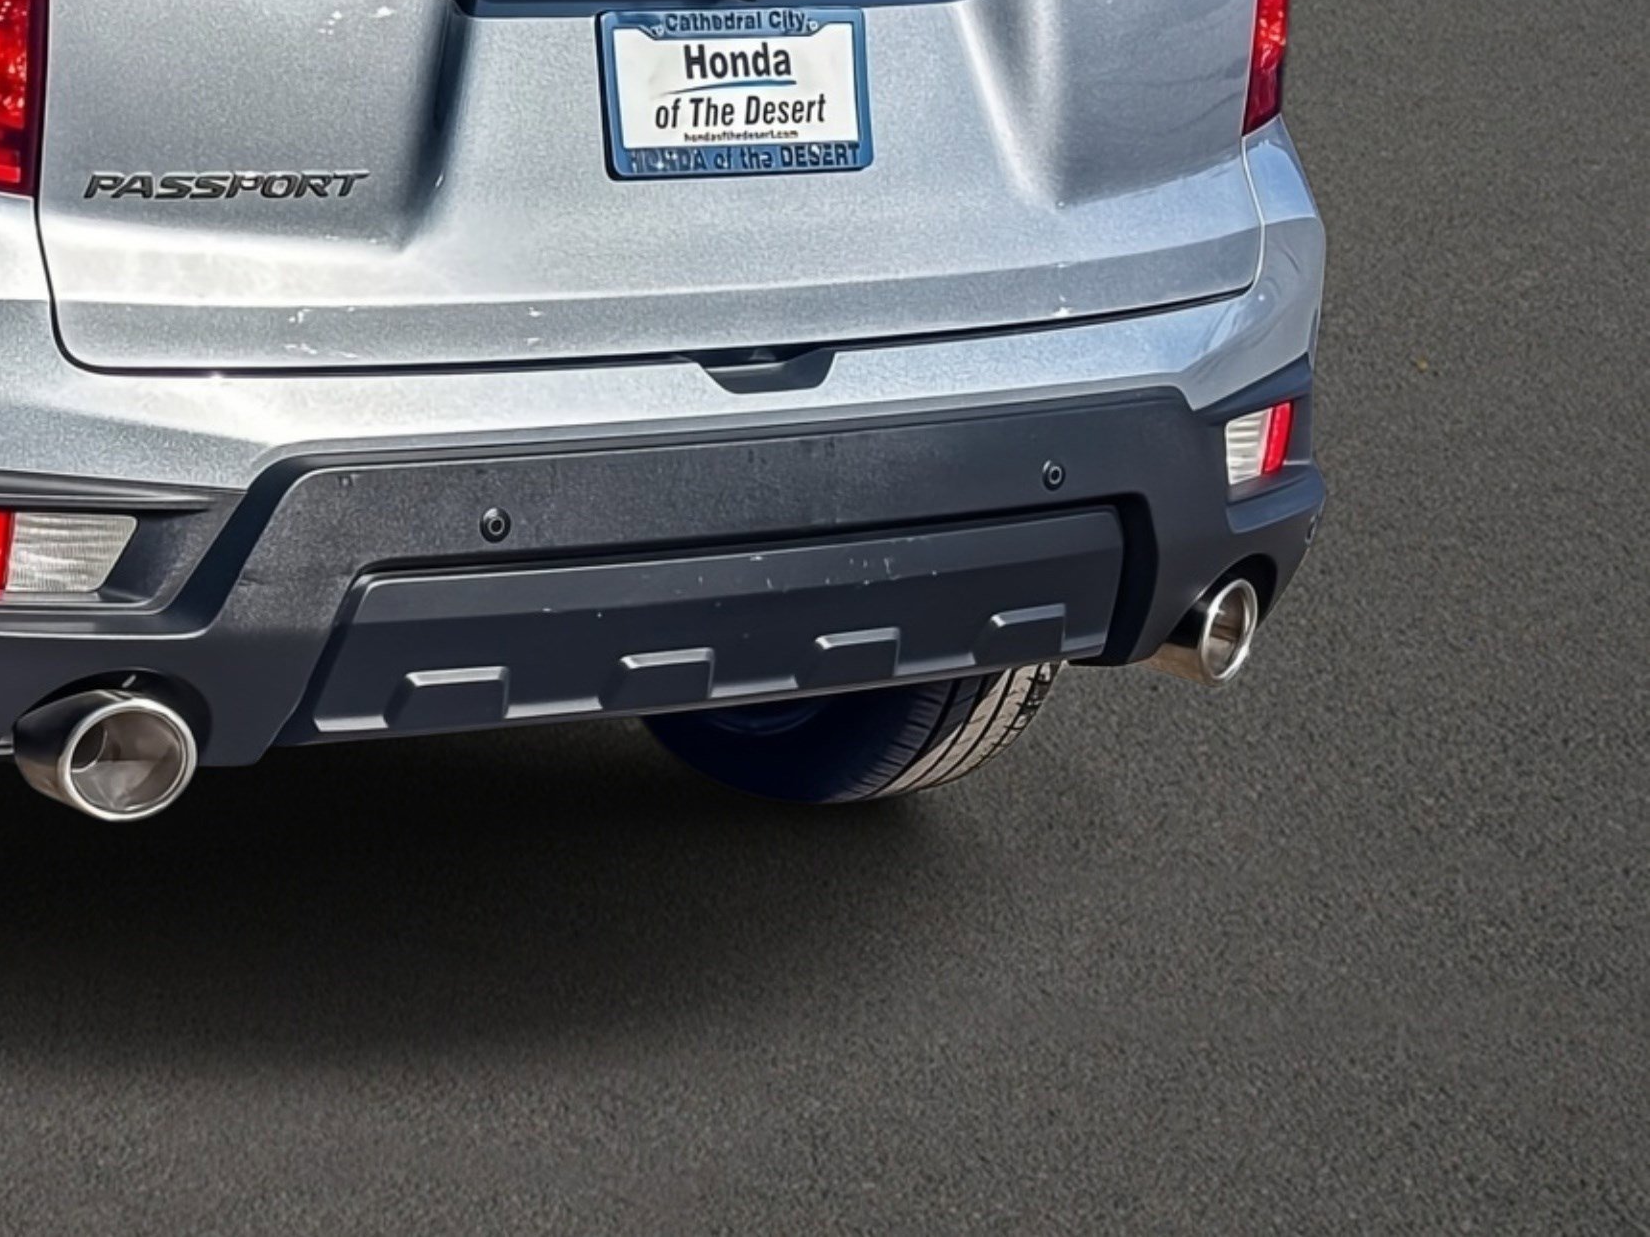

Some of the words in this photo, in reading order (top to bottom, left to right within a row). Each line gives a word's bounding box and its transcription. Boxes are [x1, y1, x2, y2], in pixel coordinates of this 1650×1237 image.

[664, 11, 762, 33] Cathedral
[683, 42, 792, 80] Honda
[655, 97, 681, 129] of
[689, 96, 735, 128] The
[744, 93, 826, 125] Desert
[713, 147, 733, 170] of
[781, 143, 859, 167] DESERT
[84, 169, 370, 199] PASSPORT
